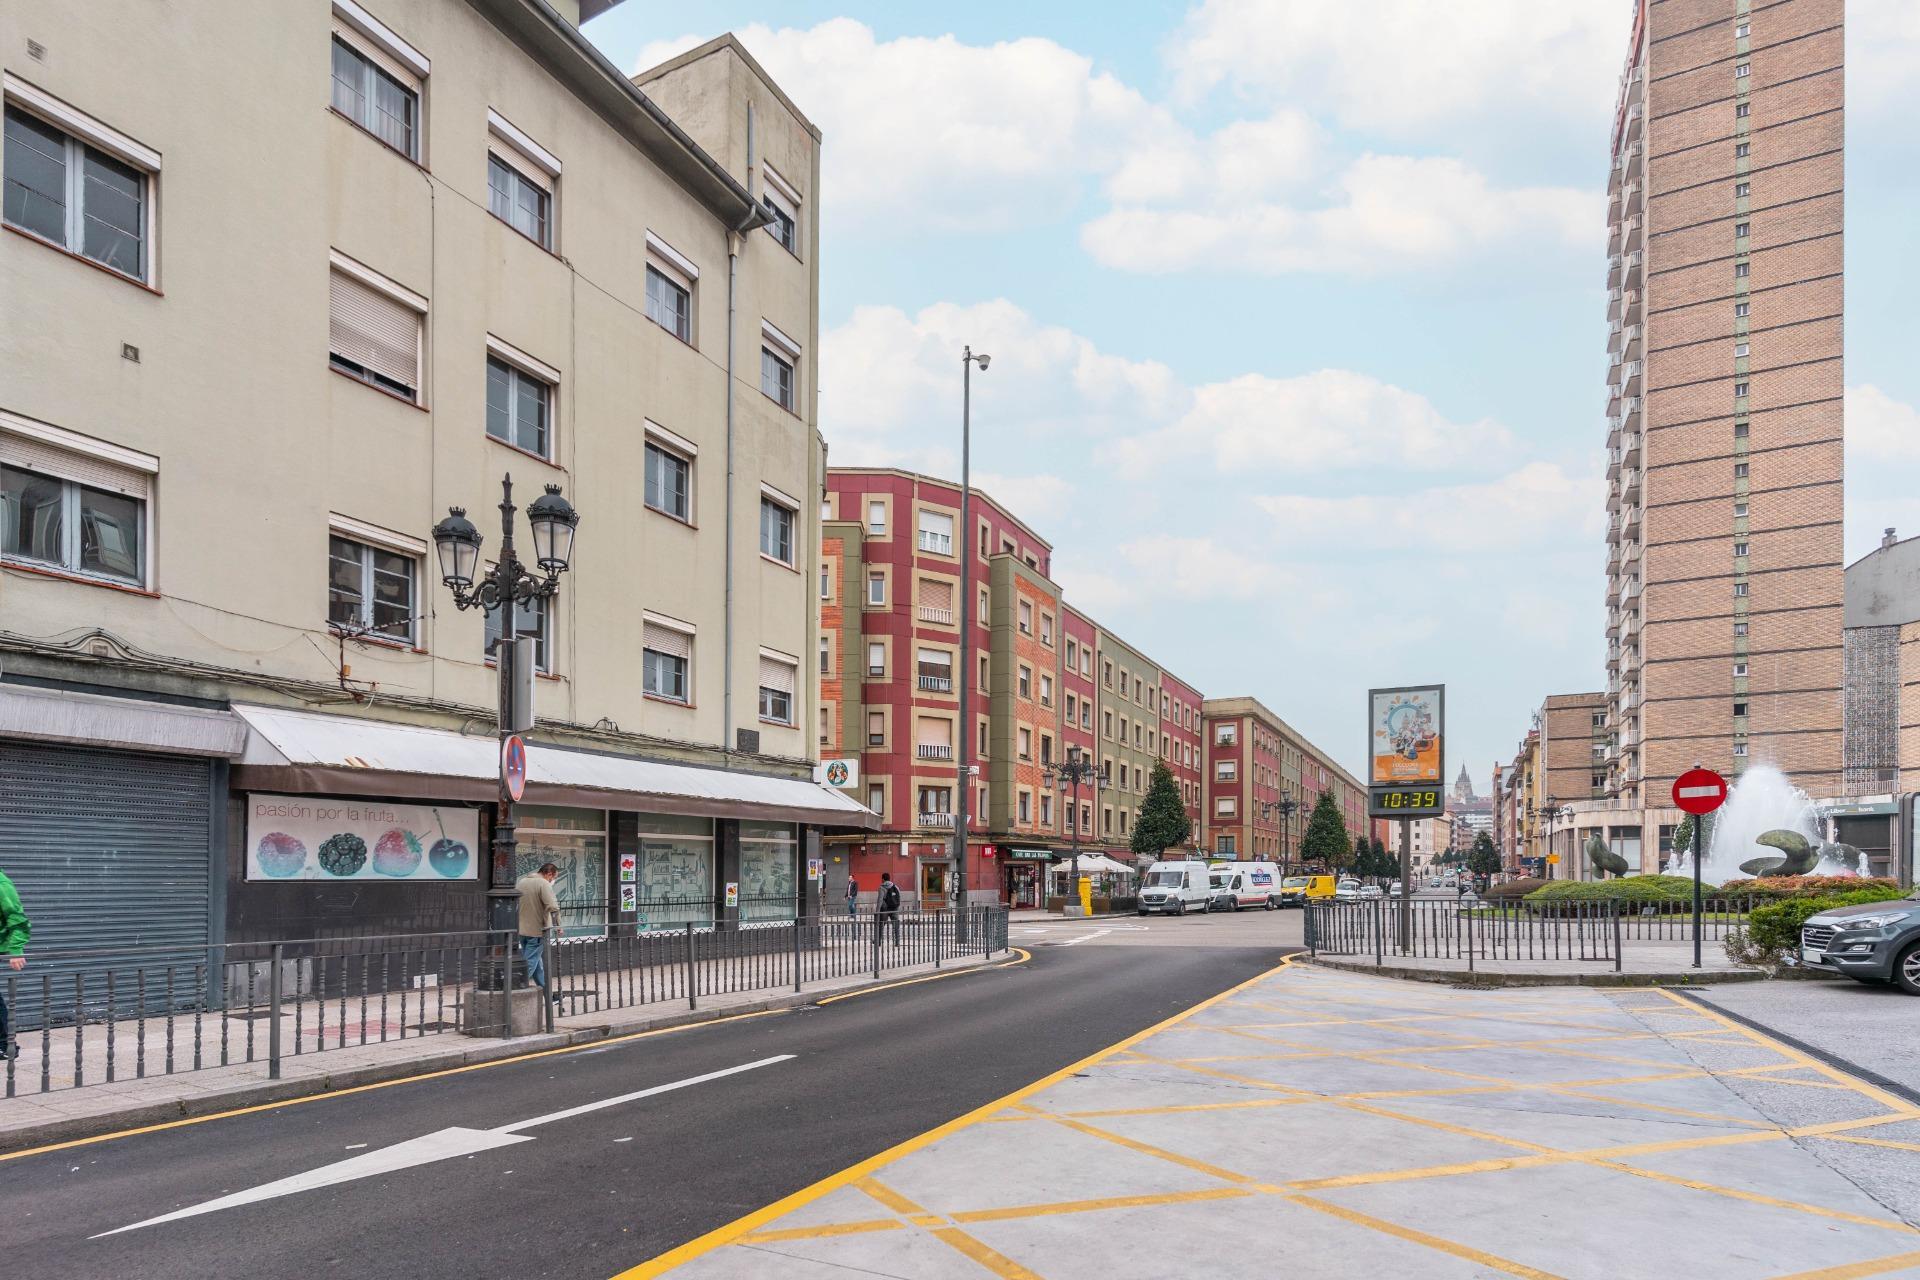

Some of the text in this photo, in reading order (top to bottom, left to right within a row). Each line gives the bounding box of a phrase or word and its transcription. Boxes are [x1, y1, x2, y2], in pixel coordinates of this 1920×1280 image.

[1384, 792, 1435, 807] 10:39
[256, 803, 311, 819] pasión
[316, 807, 342, 823] por
[347, 807, 359, 821] la
